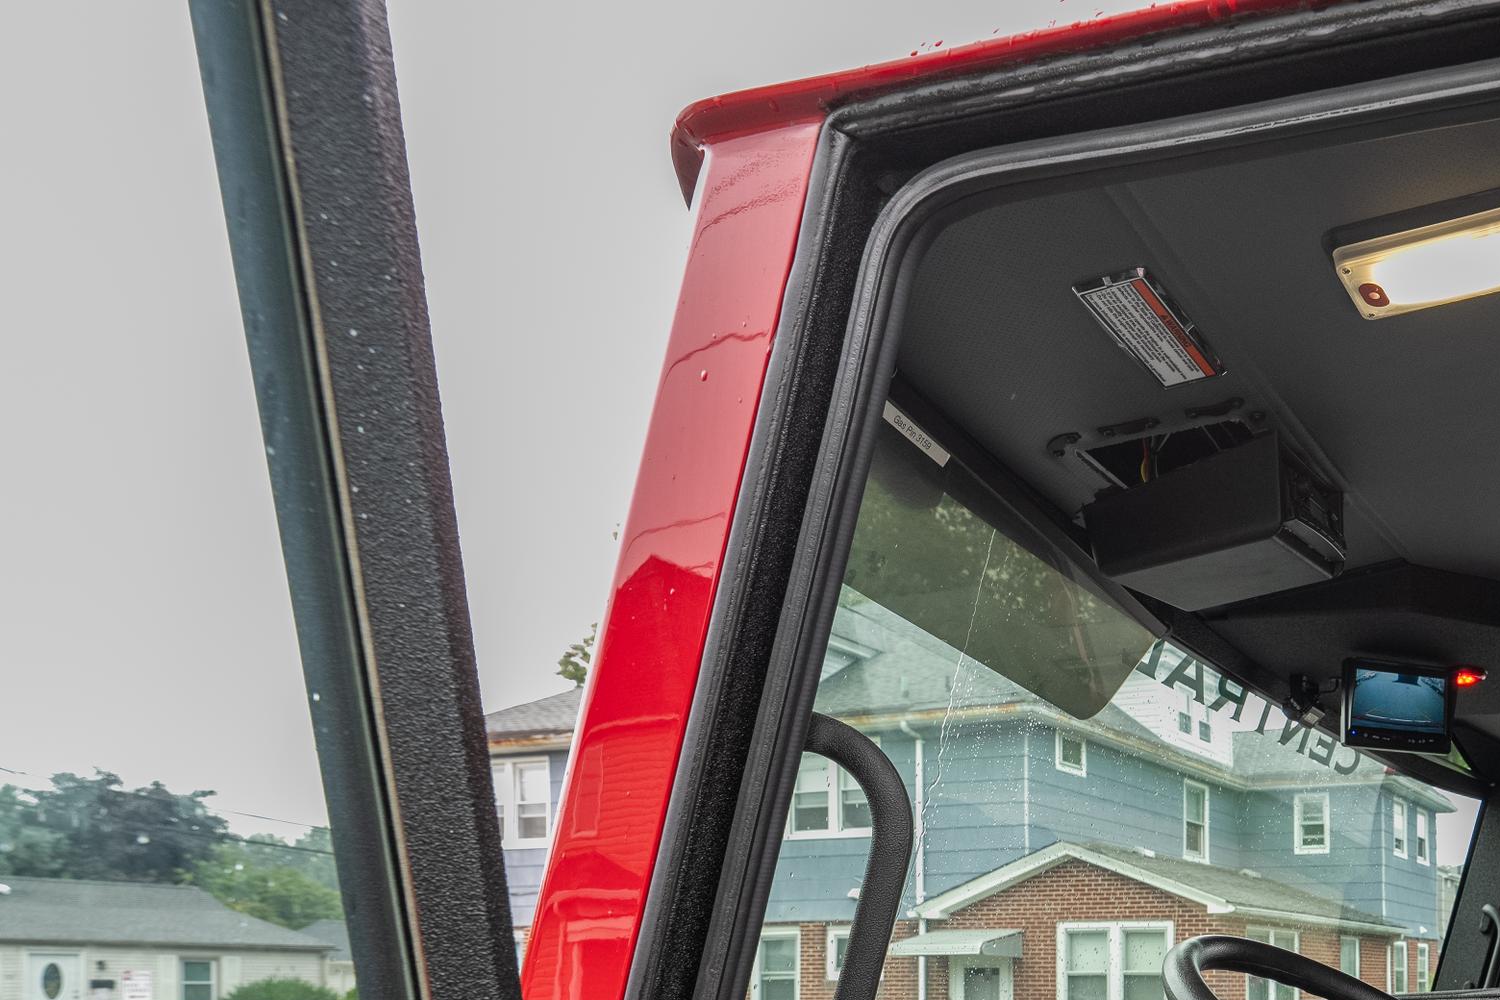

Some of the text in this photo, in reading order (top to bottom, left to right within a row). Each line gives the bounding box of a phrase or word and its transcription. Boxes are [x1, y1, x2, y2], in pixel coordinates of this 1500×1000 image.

[893, 415, 932, 450] Gas Pin 3159
